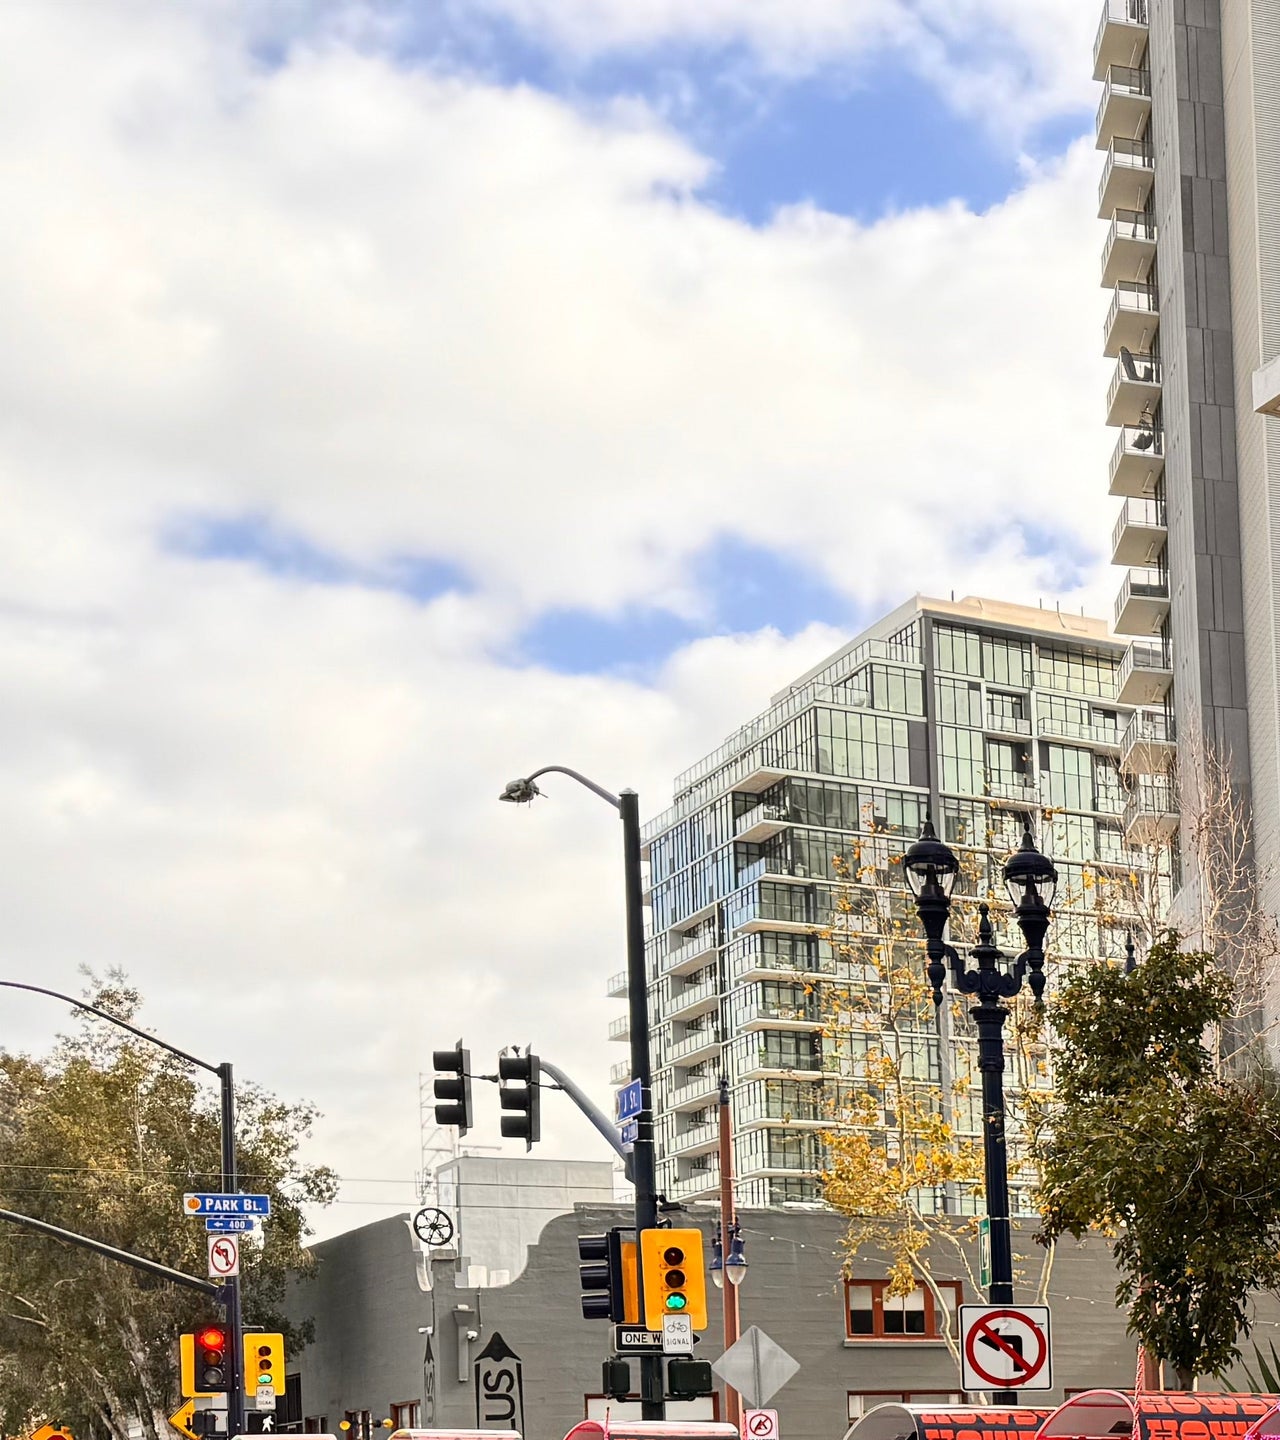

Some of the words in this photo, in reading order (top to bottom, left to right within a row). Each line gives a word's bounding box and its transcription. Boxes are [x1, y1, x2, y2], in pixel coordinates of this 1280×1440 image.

[205, 1197, 239, 1211] PARK
[243, 1198, 262, 1211] BL.
[229, 1220, 245, 1229] 400
[625, 1333, 648, 1344] ONE
[666, 1337, 689, 1346] SIGNAL
